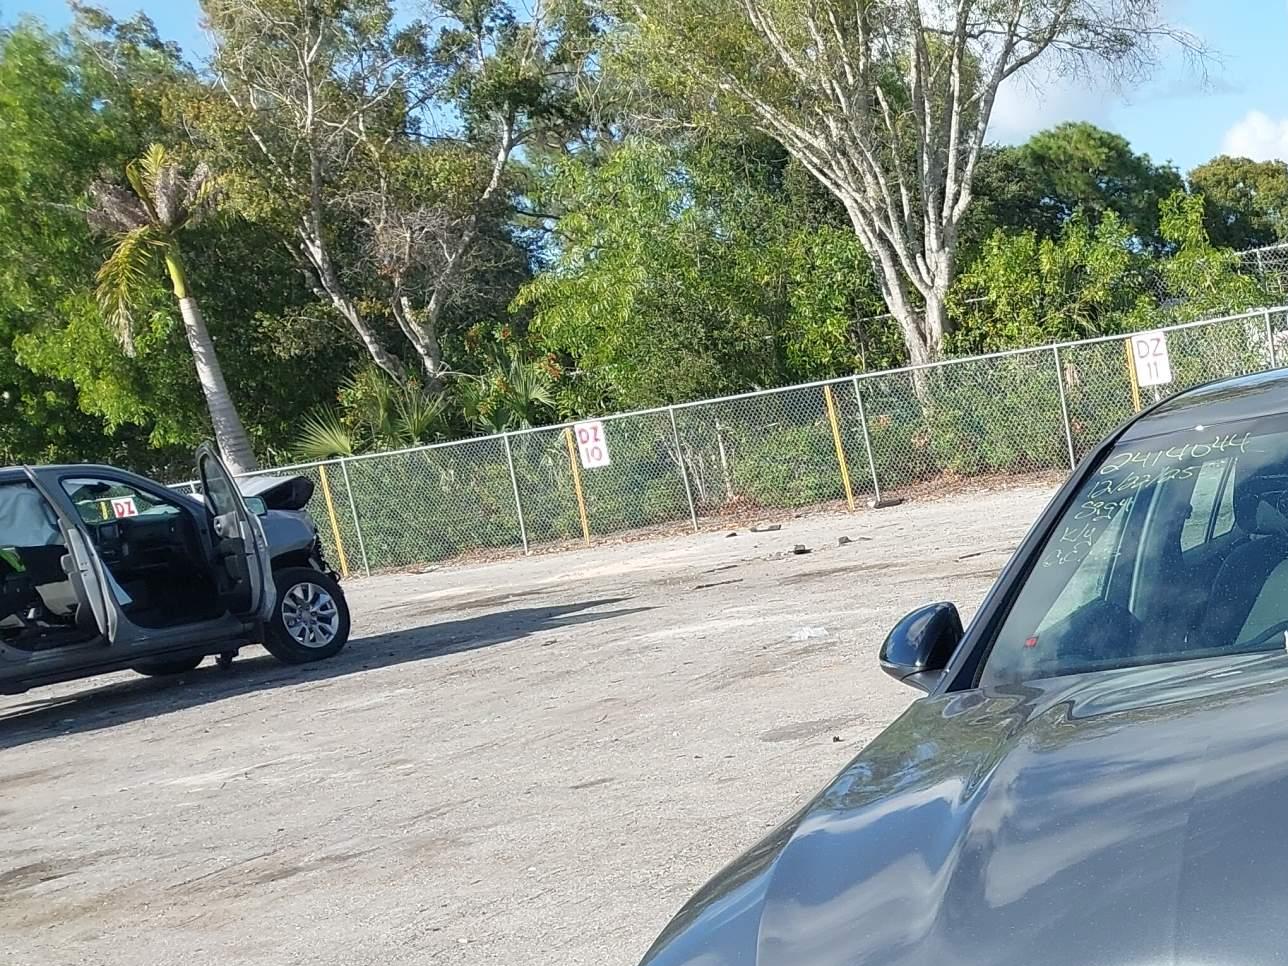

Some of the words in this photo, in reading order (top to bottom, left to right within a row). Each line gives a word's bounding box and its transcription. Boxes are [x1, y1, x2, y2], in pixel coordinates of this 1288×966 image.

[1136, 337, 1165, 359] DZ
[1147, 361, 1159, 380] 11
[578, 425, 601, 444] DZ
[584, 446, 603, 463] 10
[113, 501, 136, 517] DZ
